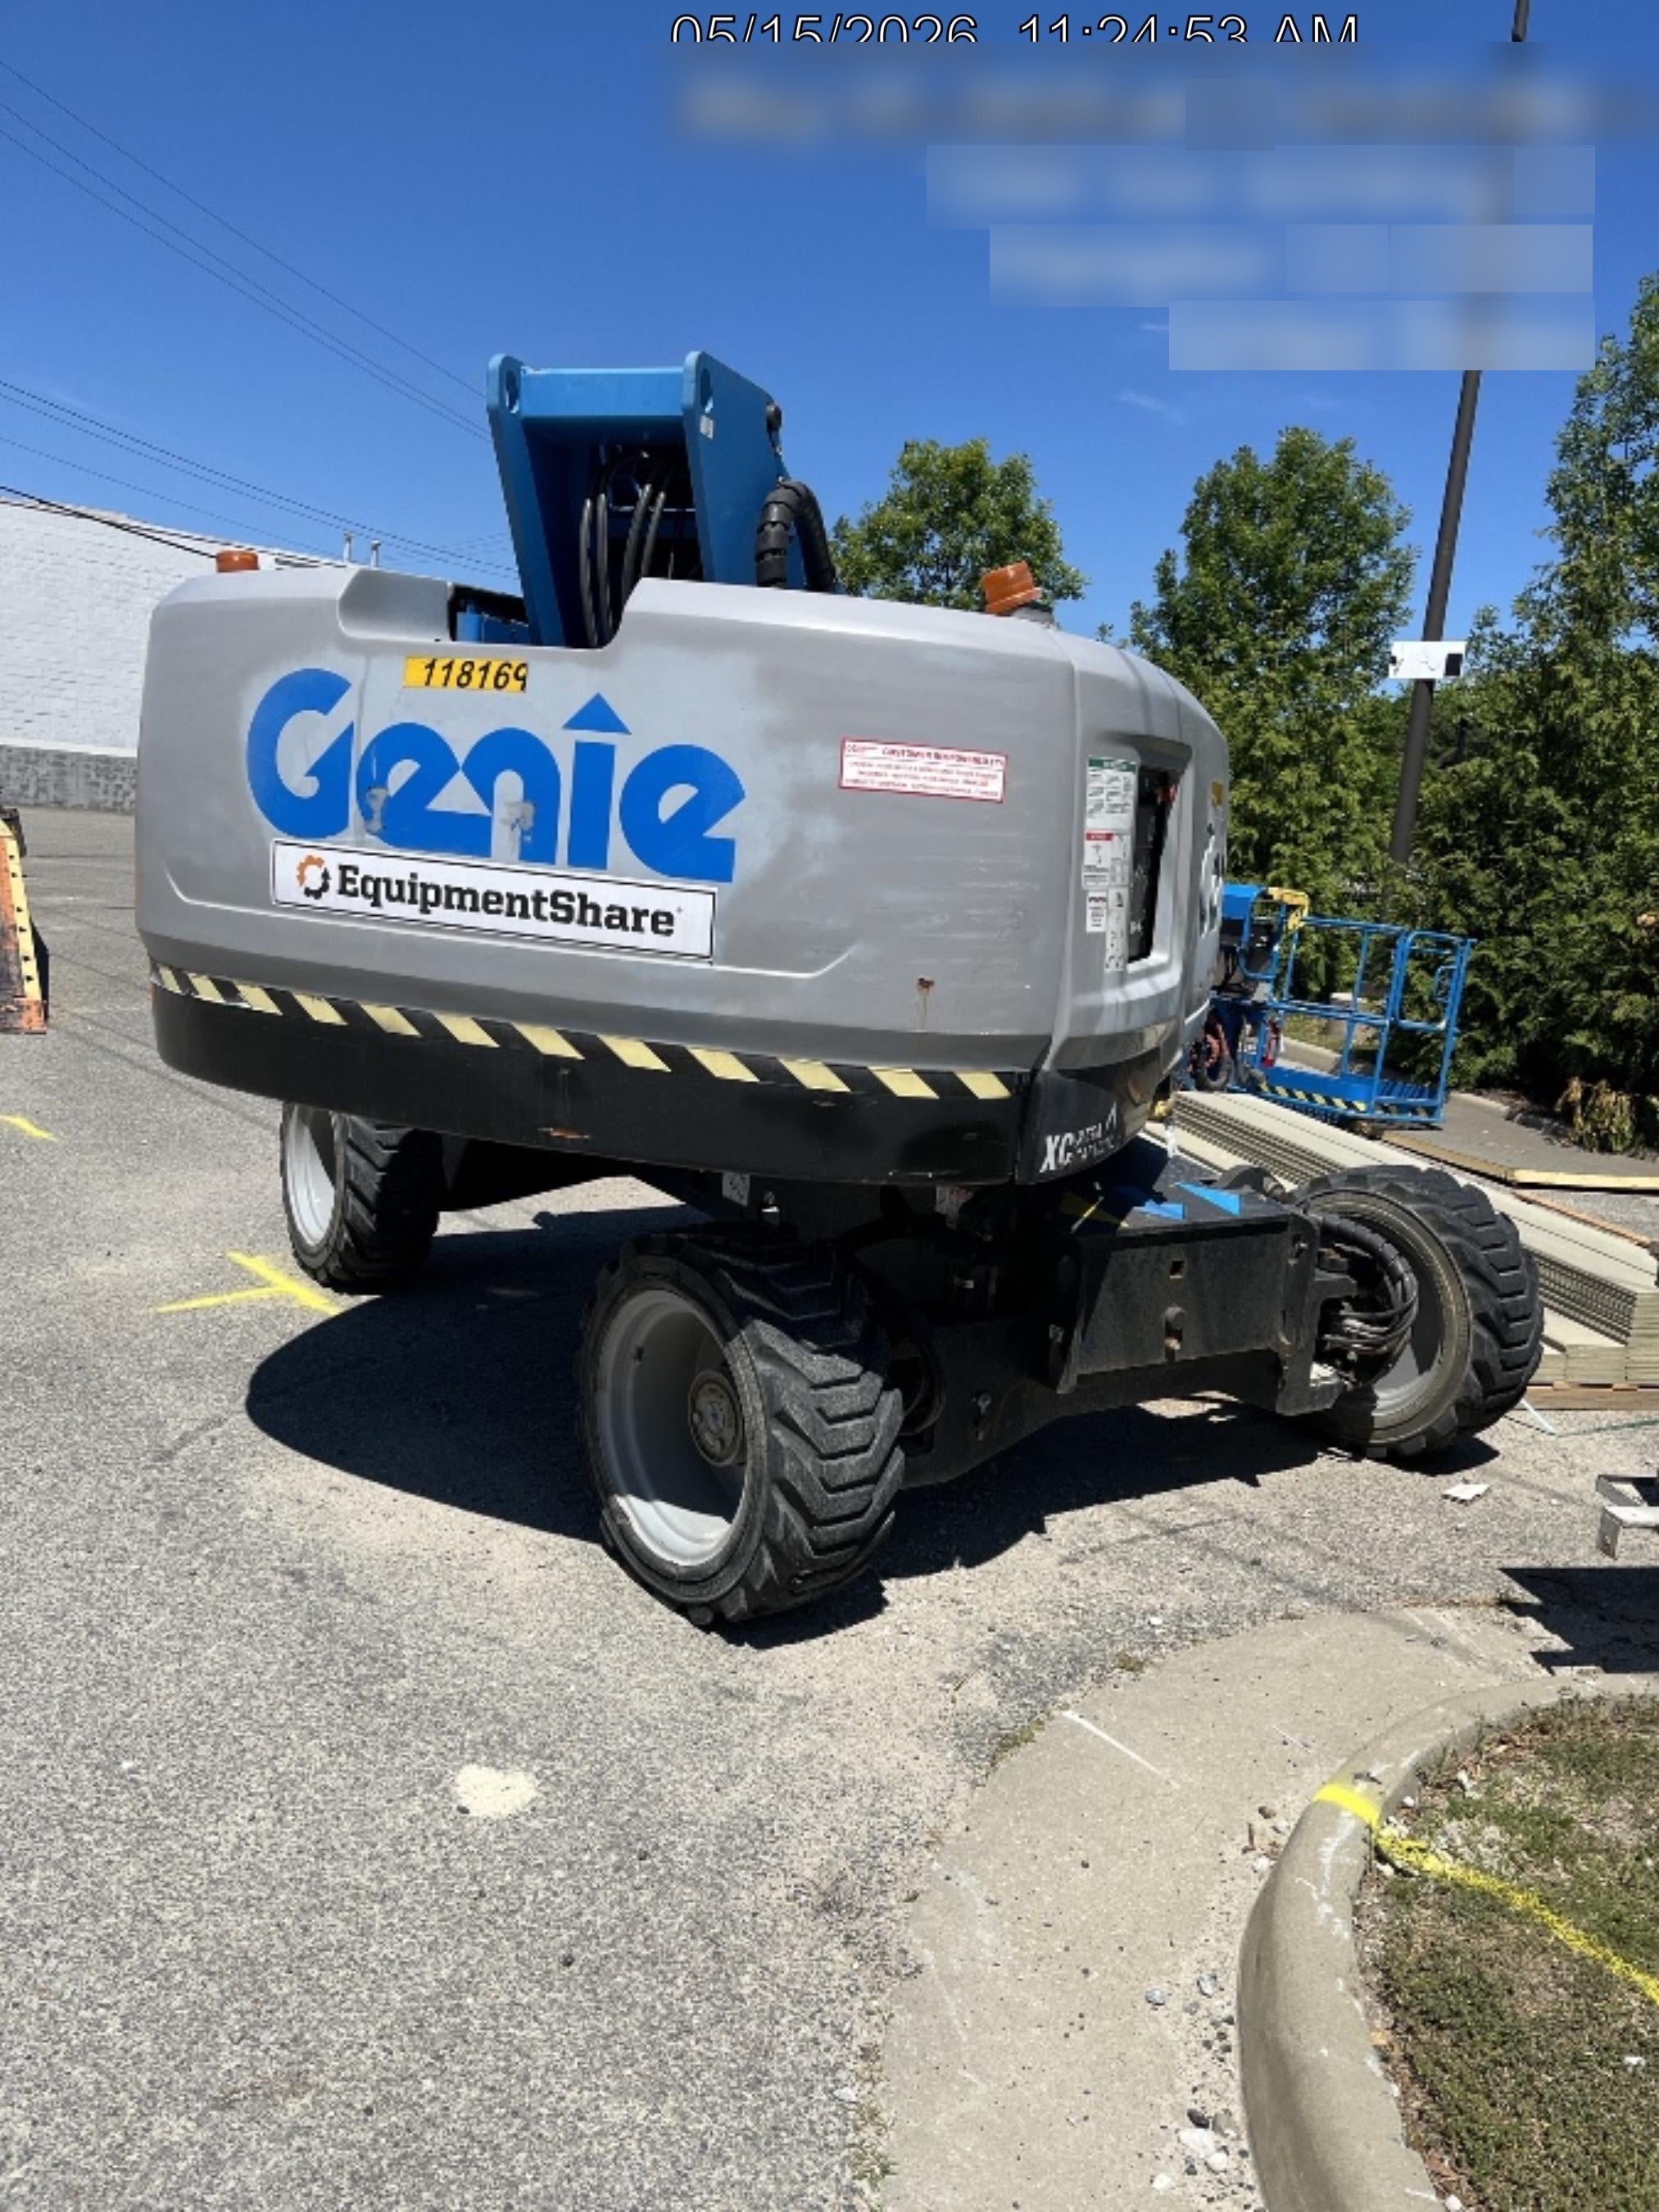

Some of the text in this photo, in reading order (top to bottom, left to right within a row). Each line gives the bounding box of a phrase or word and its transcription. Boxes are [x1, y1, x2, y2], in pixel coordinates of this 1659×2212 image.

[424, 658, 528, 693] 118169
[247, 668, 746, 882] Genie
[337, 863, 675, 936] EquipmentShare
